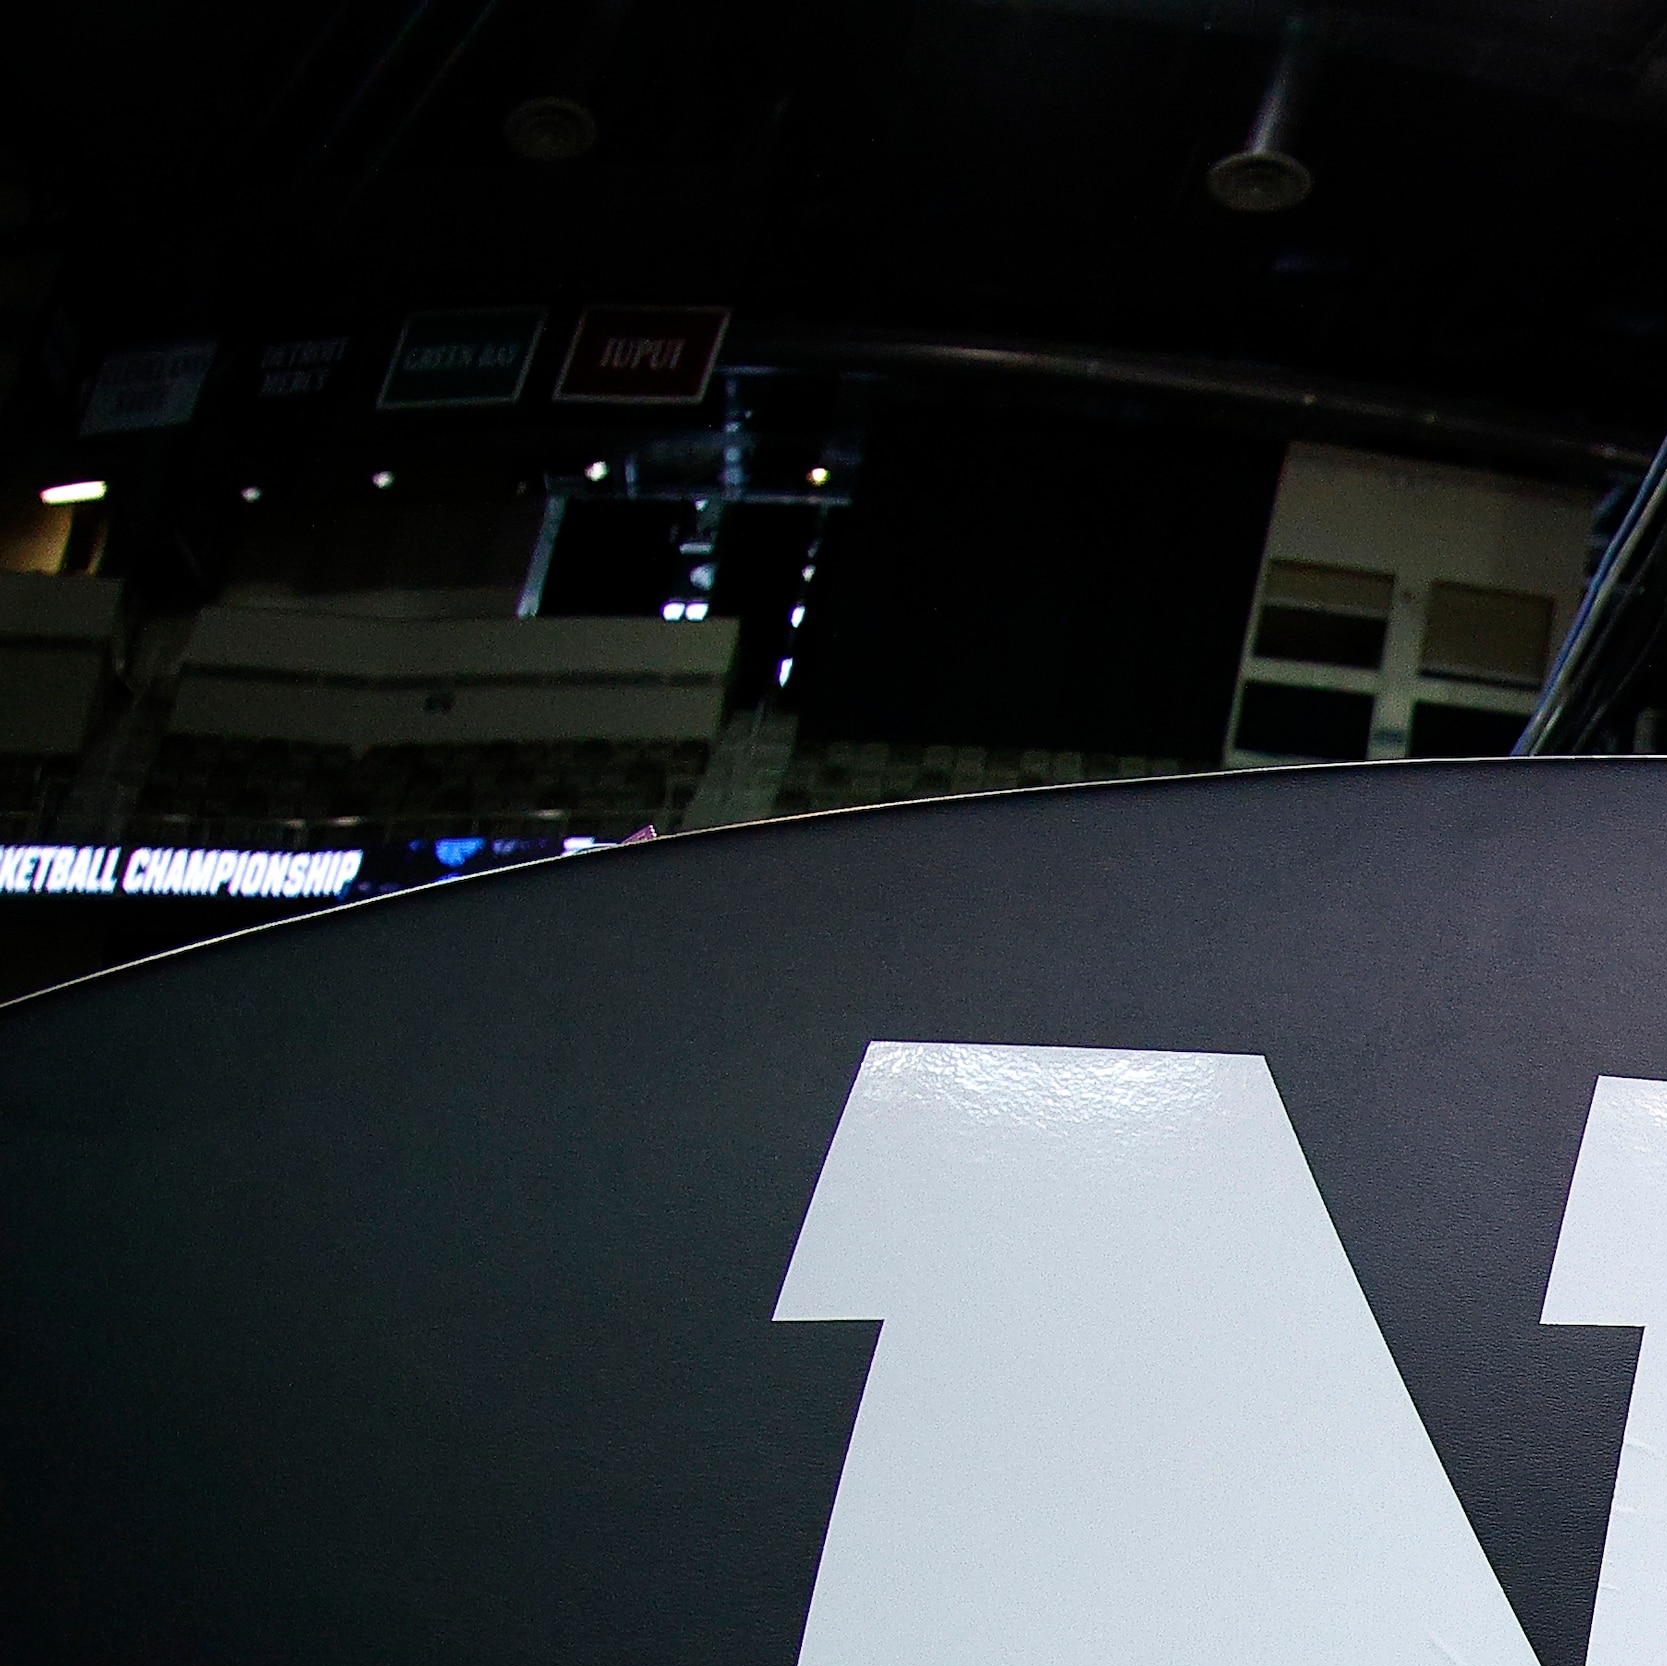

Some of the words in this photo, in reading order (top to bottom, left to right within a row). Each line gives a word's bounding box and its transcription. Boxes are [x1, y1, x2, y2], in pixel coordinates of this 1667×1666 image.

[402, 342, 474, 372] GREEN
[599, 337, 687, 371] IUPUI
[0, 846, 120, 894] KETBALL
[123, 848, 363, 898] CHAMPIONSHIP
